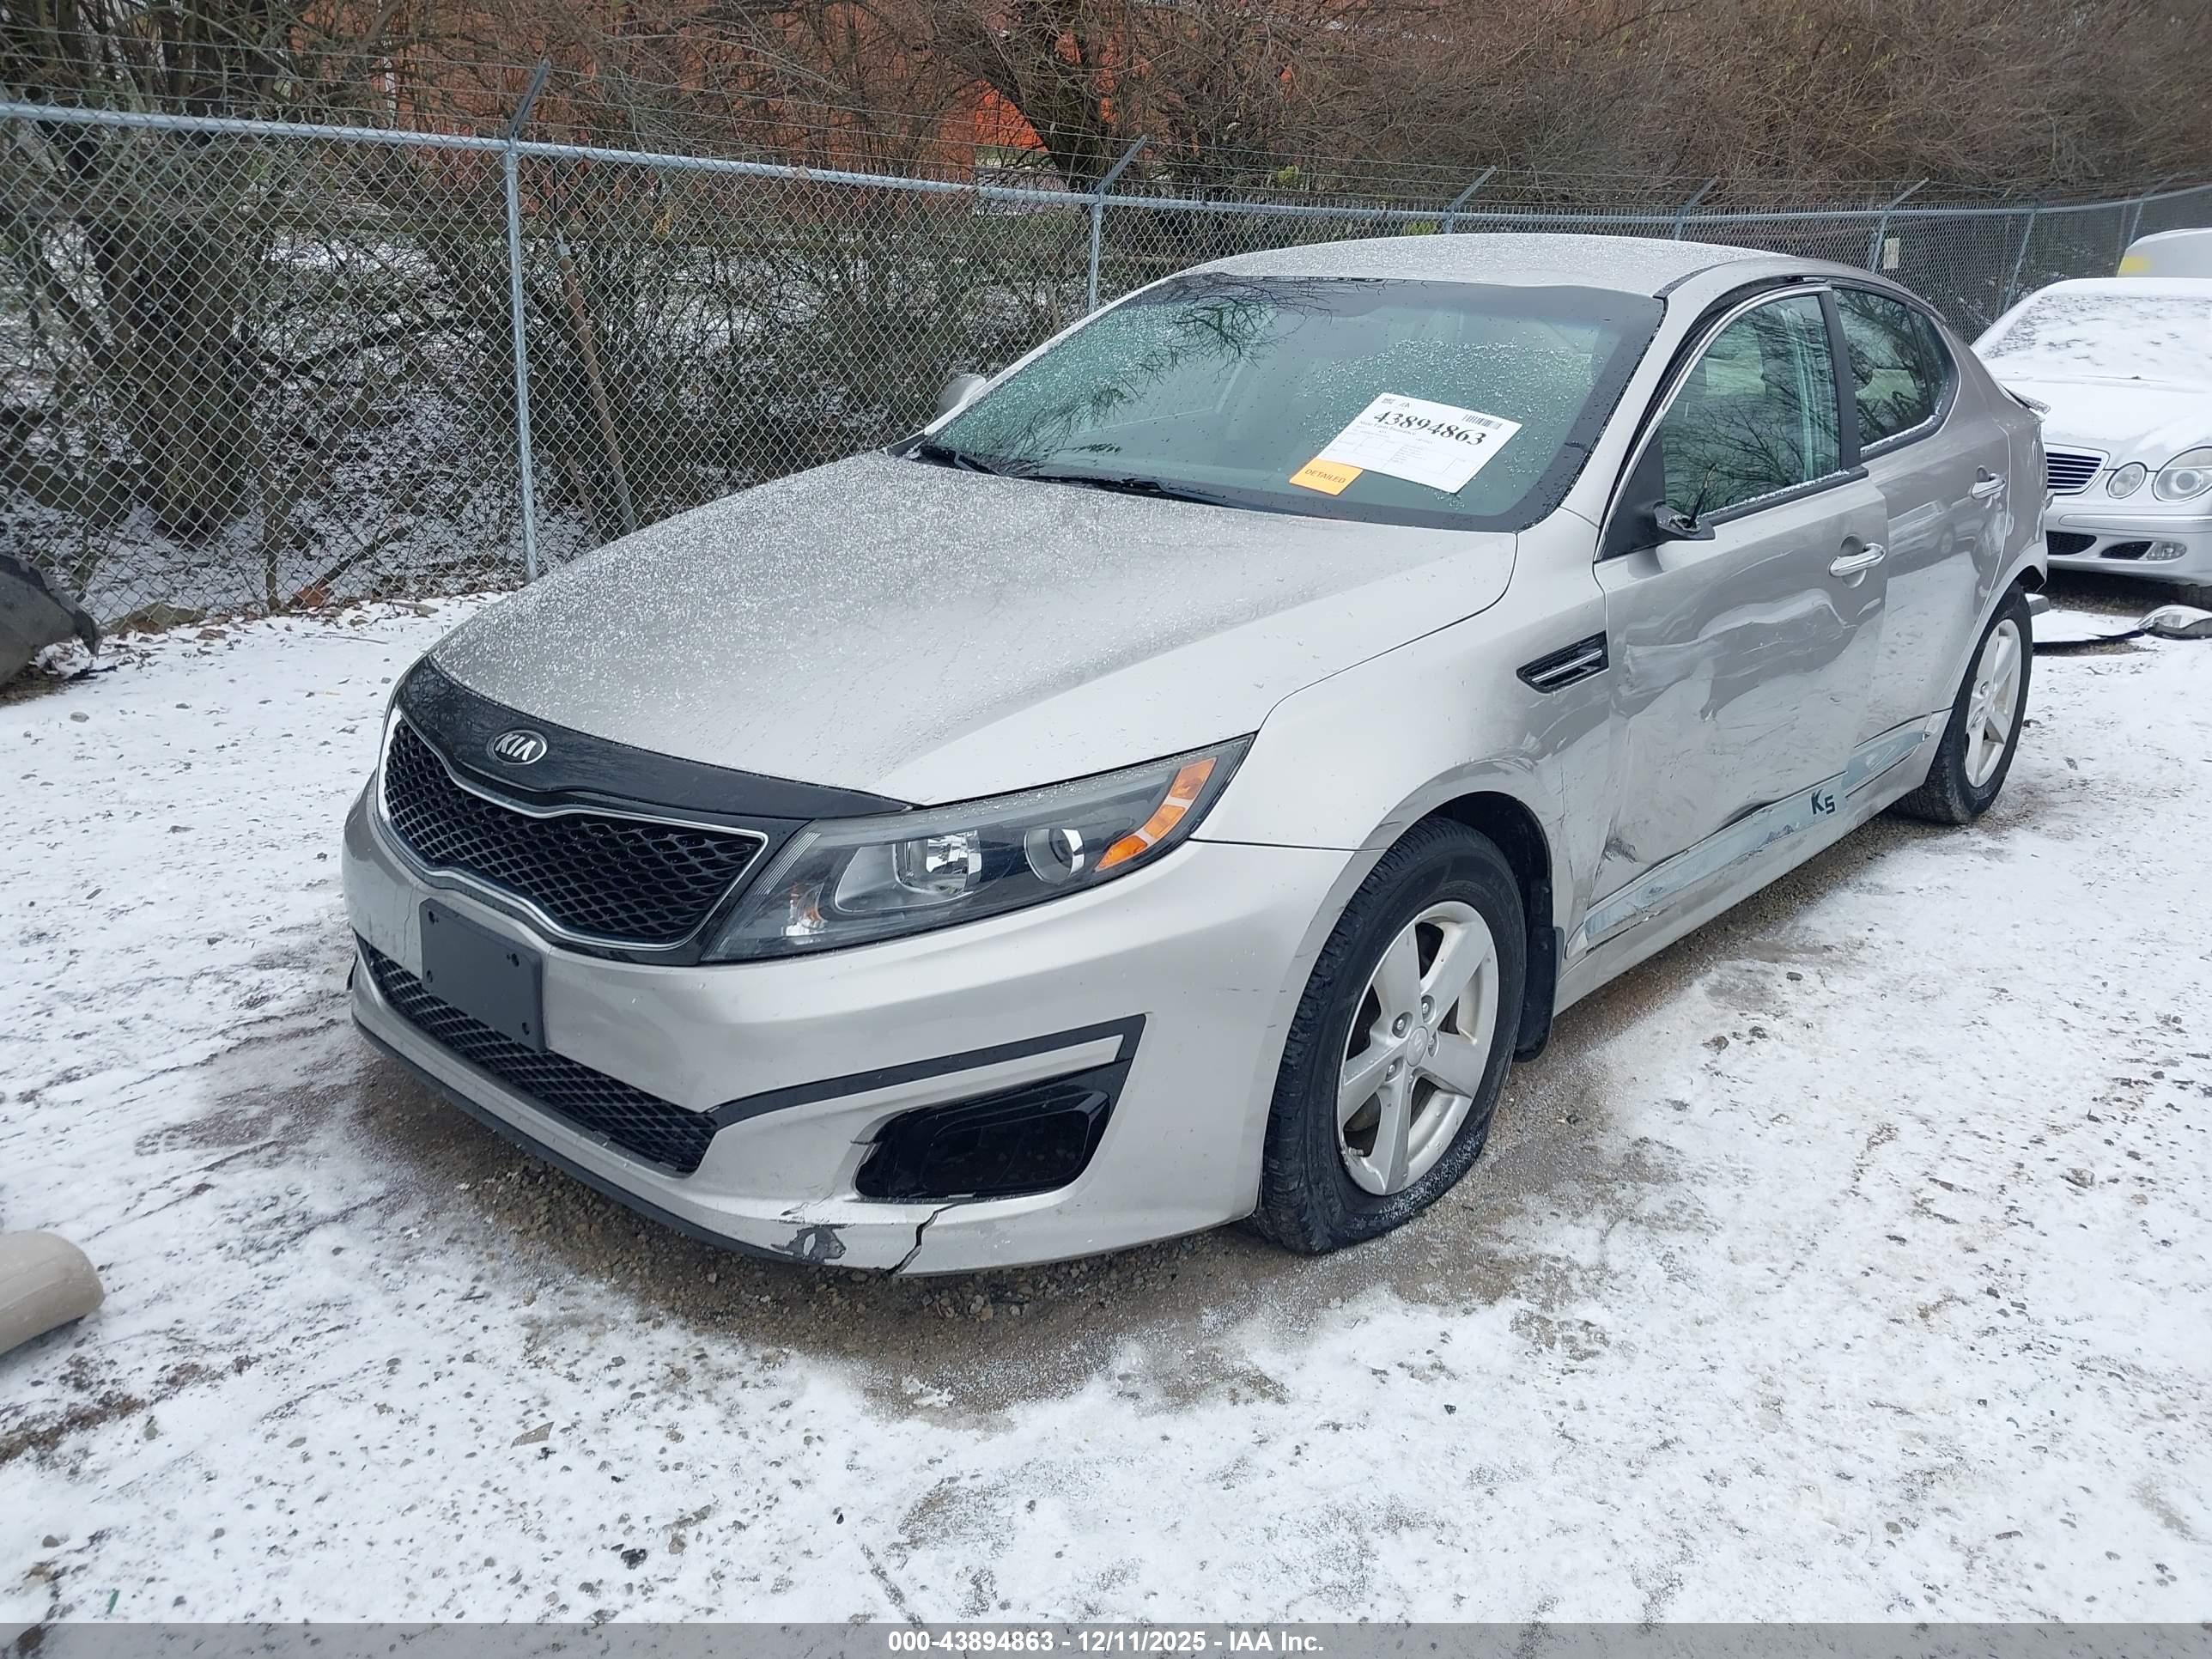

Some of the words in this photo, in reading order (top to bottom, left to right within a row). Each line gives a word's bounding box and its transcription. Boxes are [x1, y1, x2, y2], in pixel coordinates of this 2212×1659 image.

[1373, 410, 1487, 447] 43894863
[1304, 468, 1346, 484] DETAILED
[495, 733, 538, 761] KIA
